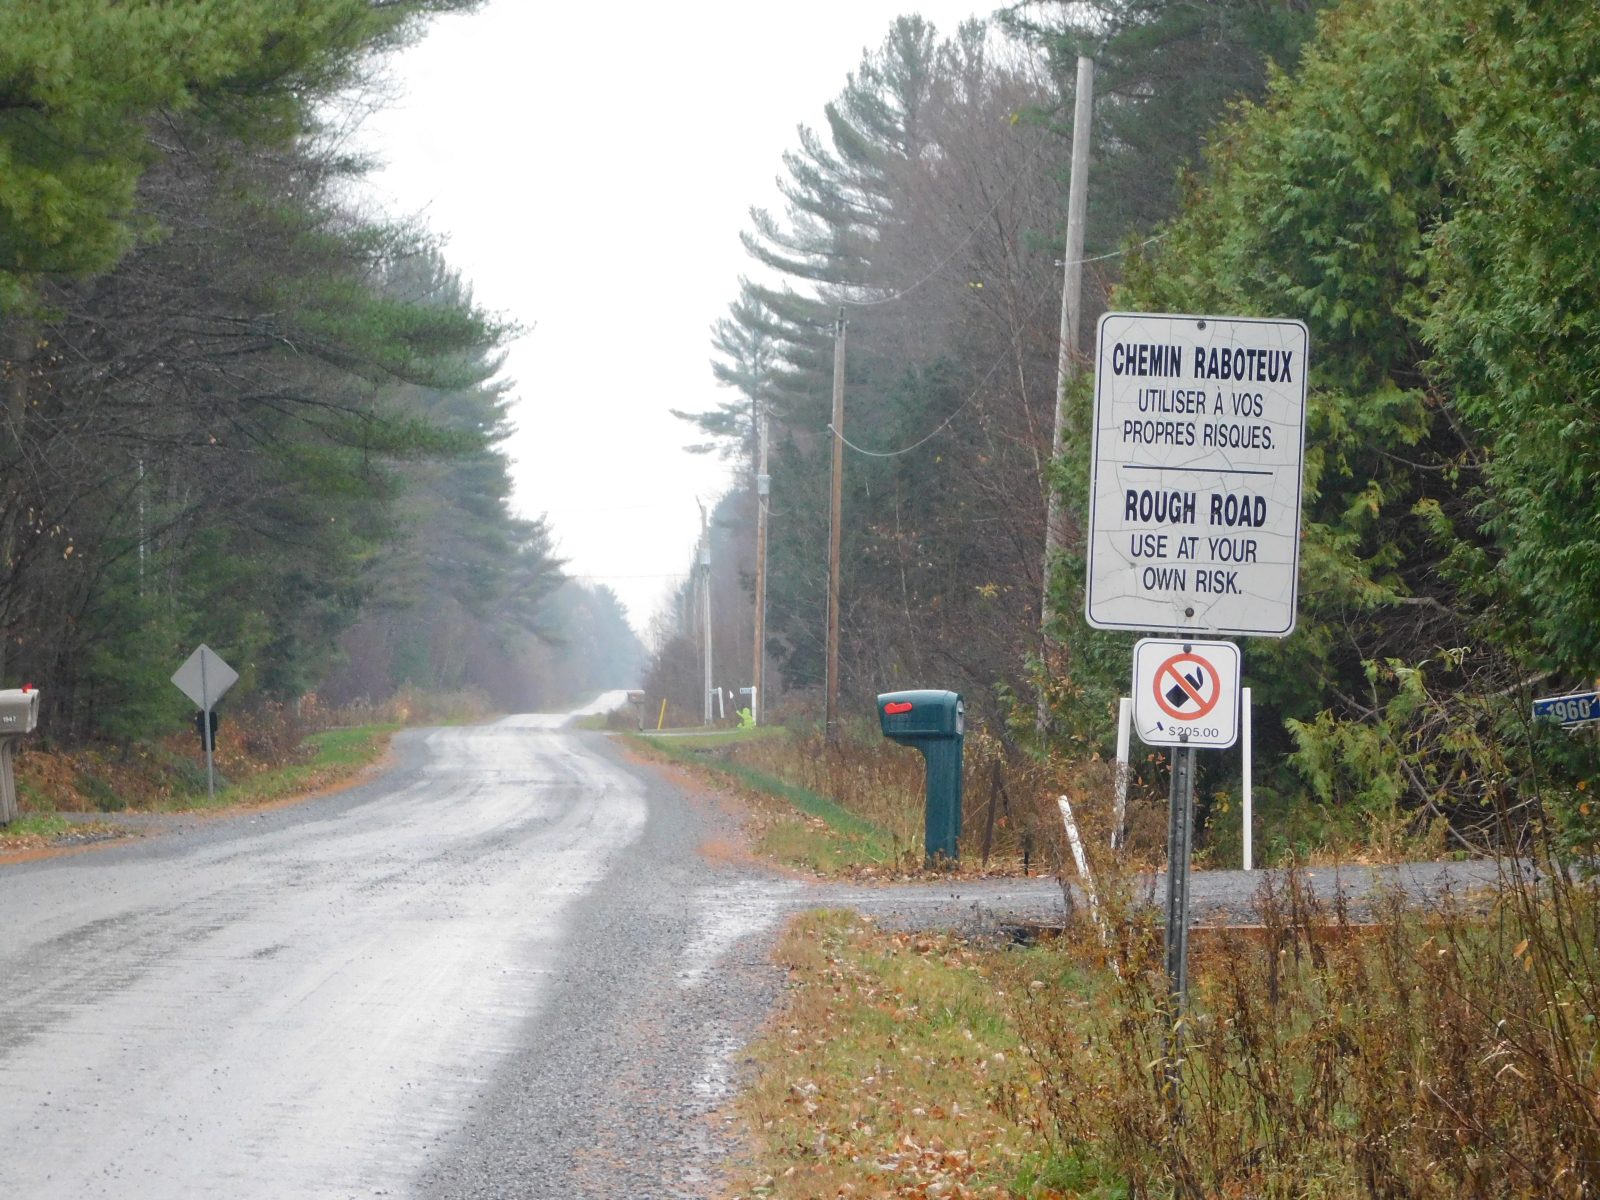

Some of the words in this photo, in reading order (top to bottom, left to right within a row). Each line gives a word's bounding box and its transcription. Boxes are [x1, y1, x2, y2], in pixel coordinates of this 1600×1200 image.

[1112, 342, 1182, 378] CHEMIN
[1193, 346, 1293, 383] RABOTEUX
[1138, 388, 1207, 415] UTILISER
[1213, 386, 1225, 415] À
[1231, 392, 1263, 418] VOS
[1123, 419, 1196, 447] PROPRES
[1203, 423, 1275, 450] RISQUES.
[1124, 489, 1197, 525] ROUGH
[1209, 493, 1267, 528] ROAD
[1130, 534, 1168, 558] USE
[1176, 536, 1200, 560] AT
[1208, 537, 1257, 564] YOUR
[1142, 566, 1186, 592] OWN
[1195, 569, 1242, 595] RISK.
